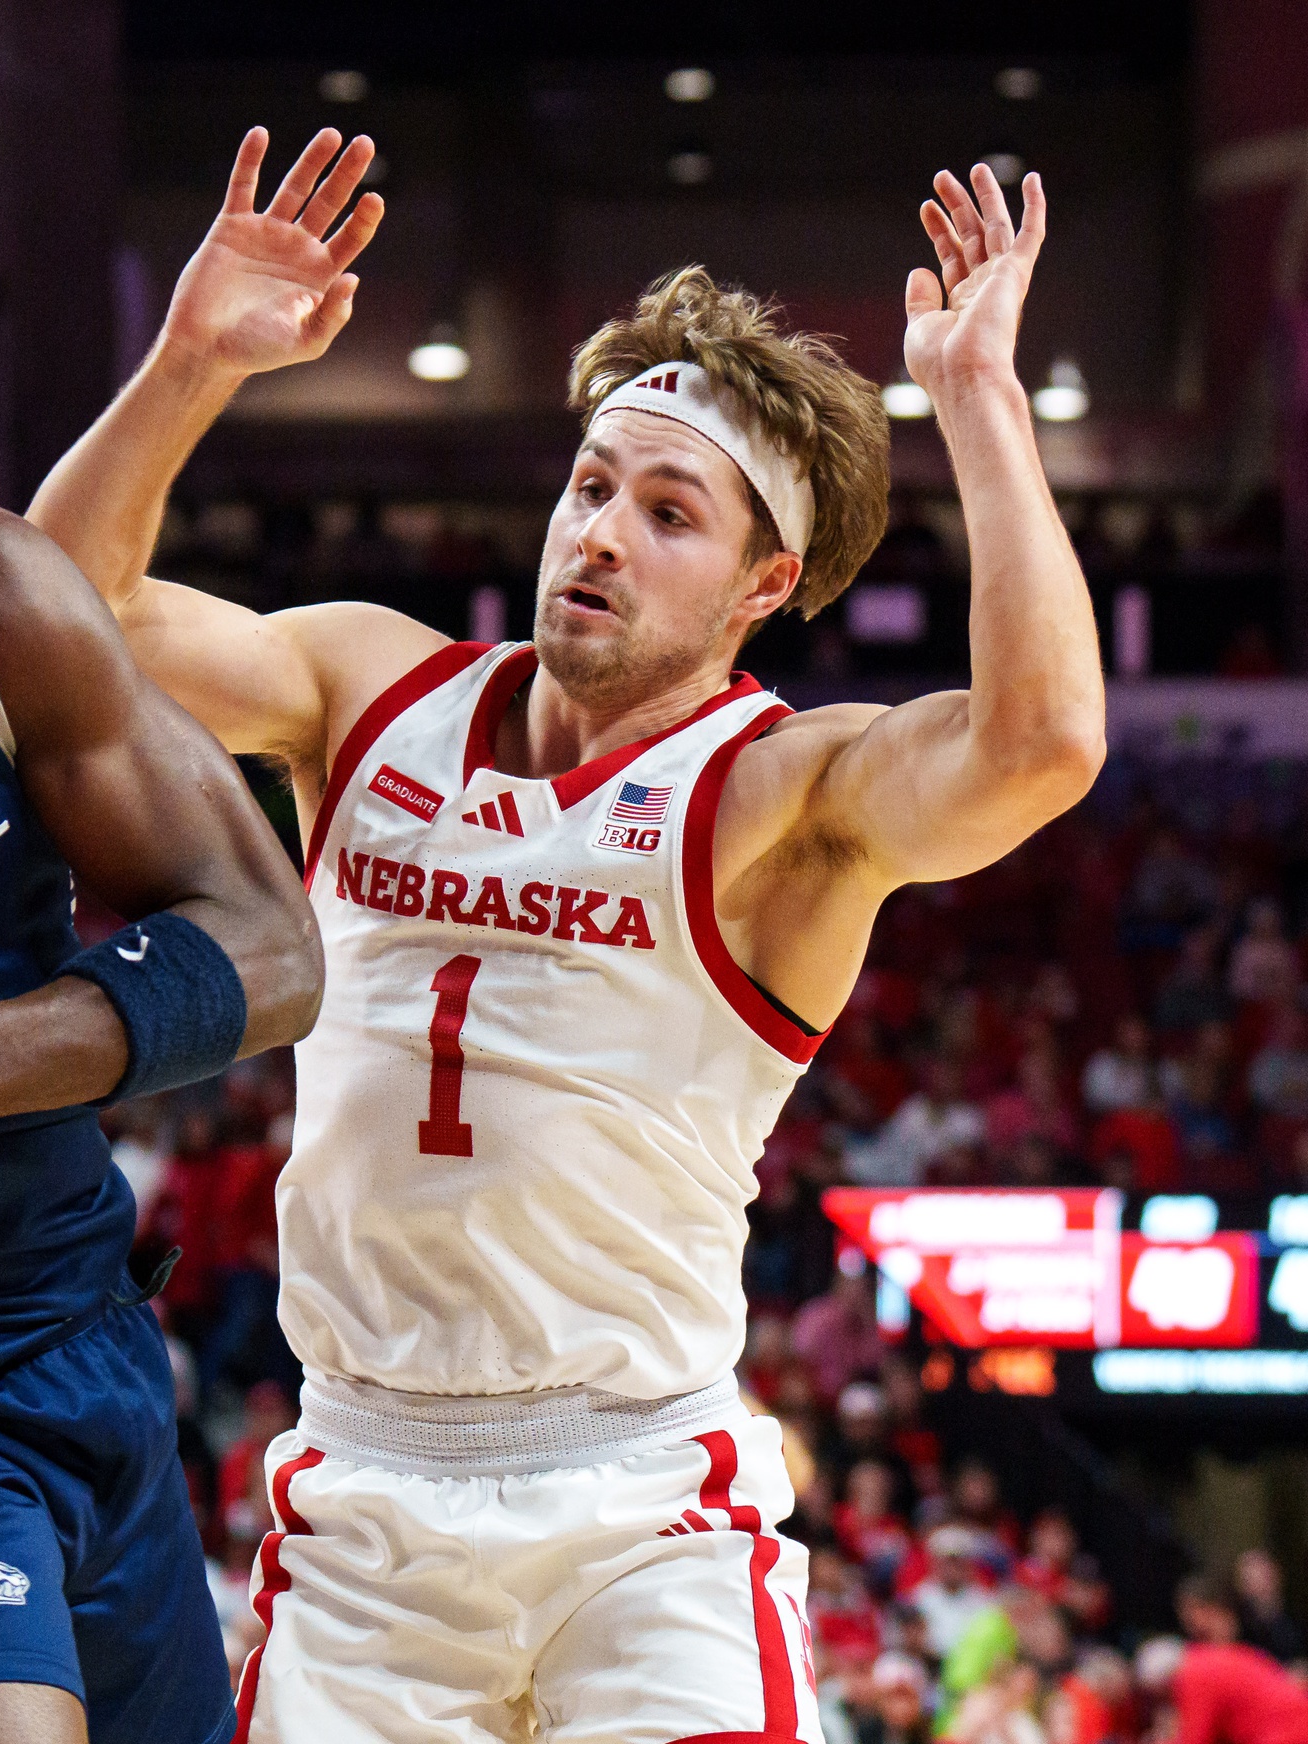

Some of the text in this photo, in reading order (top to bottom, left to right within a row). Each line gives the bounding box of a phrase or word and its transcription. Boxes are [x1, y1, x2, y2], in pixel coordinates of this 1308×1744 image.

[377, 775, 437, 814] GRADUATE
[337, 847, 657, 950] NEBRASKA
[418, 954, 482, 1158] 1
